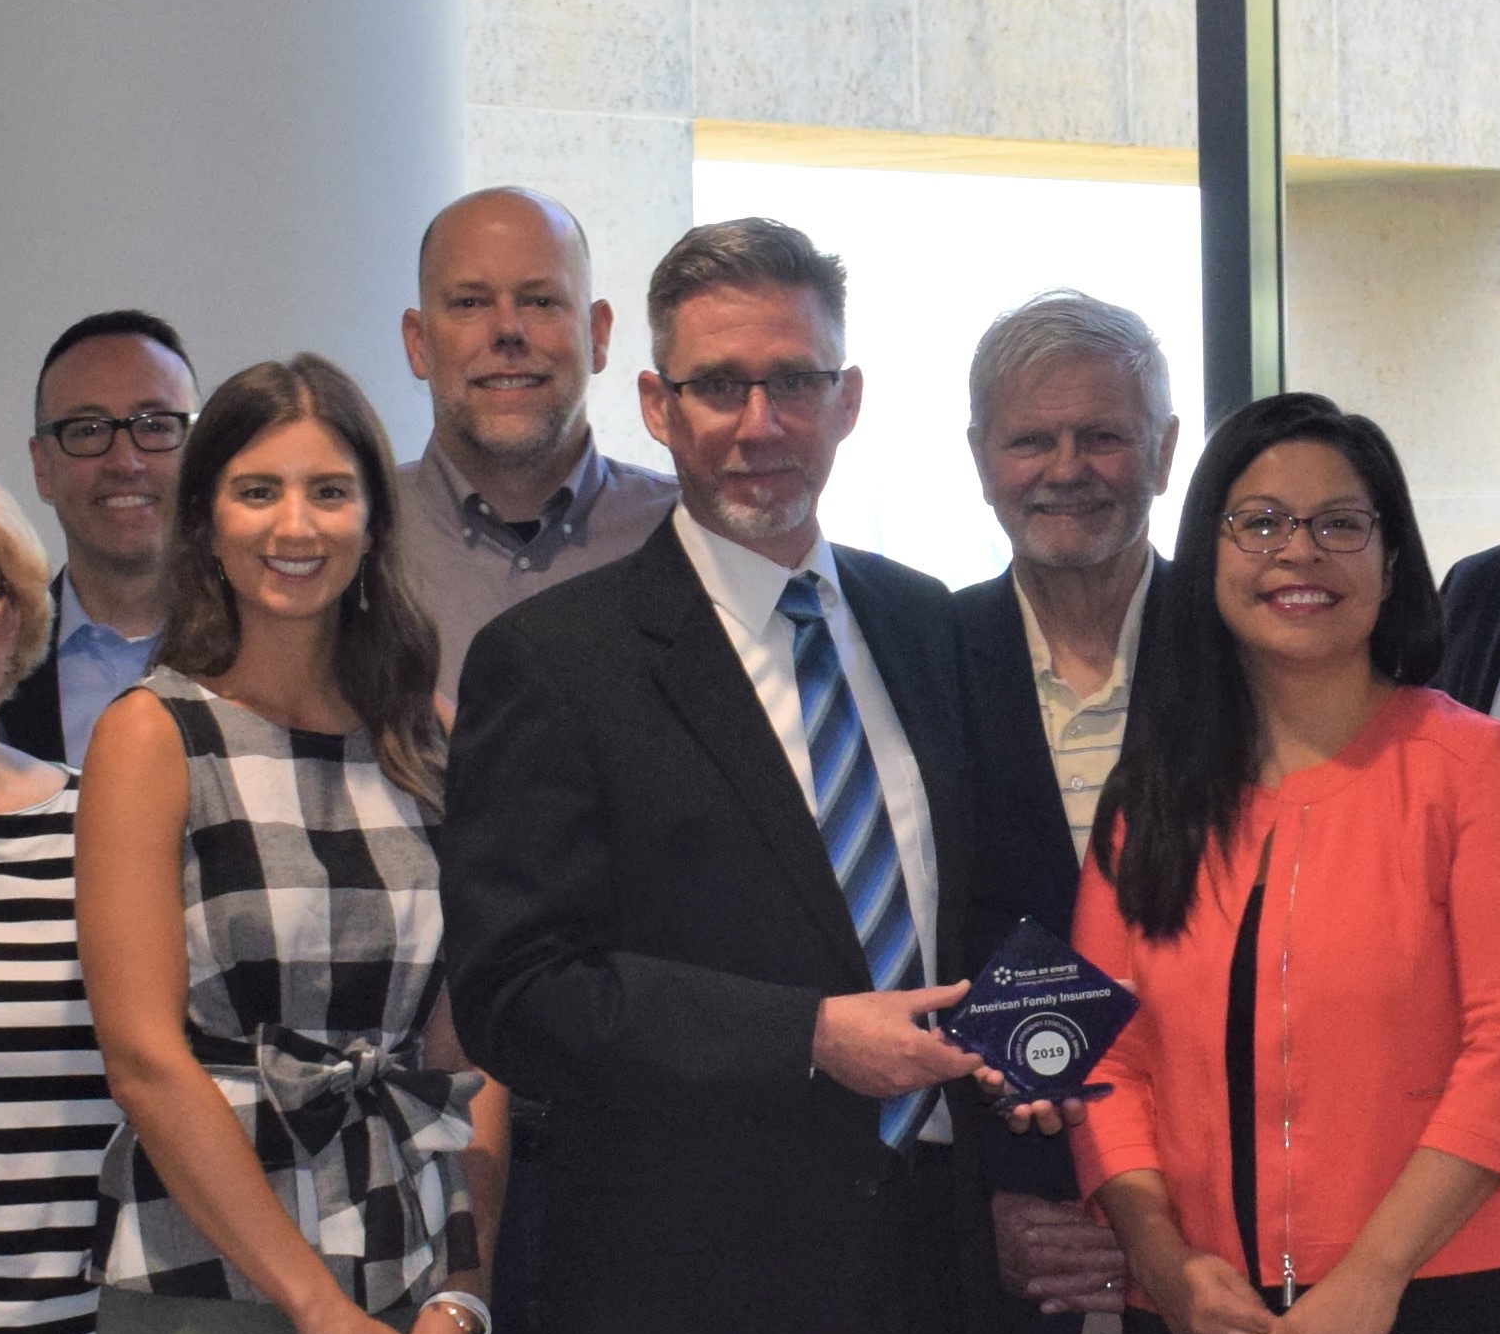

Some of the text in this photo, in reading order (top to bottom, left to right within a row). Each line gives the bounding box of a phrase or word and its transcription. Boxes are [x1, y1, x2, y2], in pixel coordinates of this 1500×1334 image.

[1014, 964, 1078, 978] focus on energy
[970, 988, 1111, 1015] American Family Insurance
[1032, 1046, 1065, 1060] 2019
